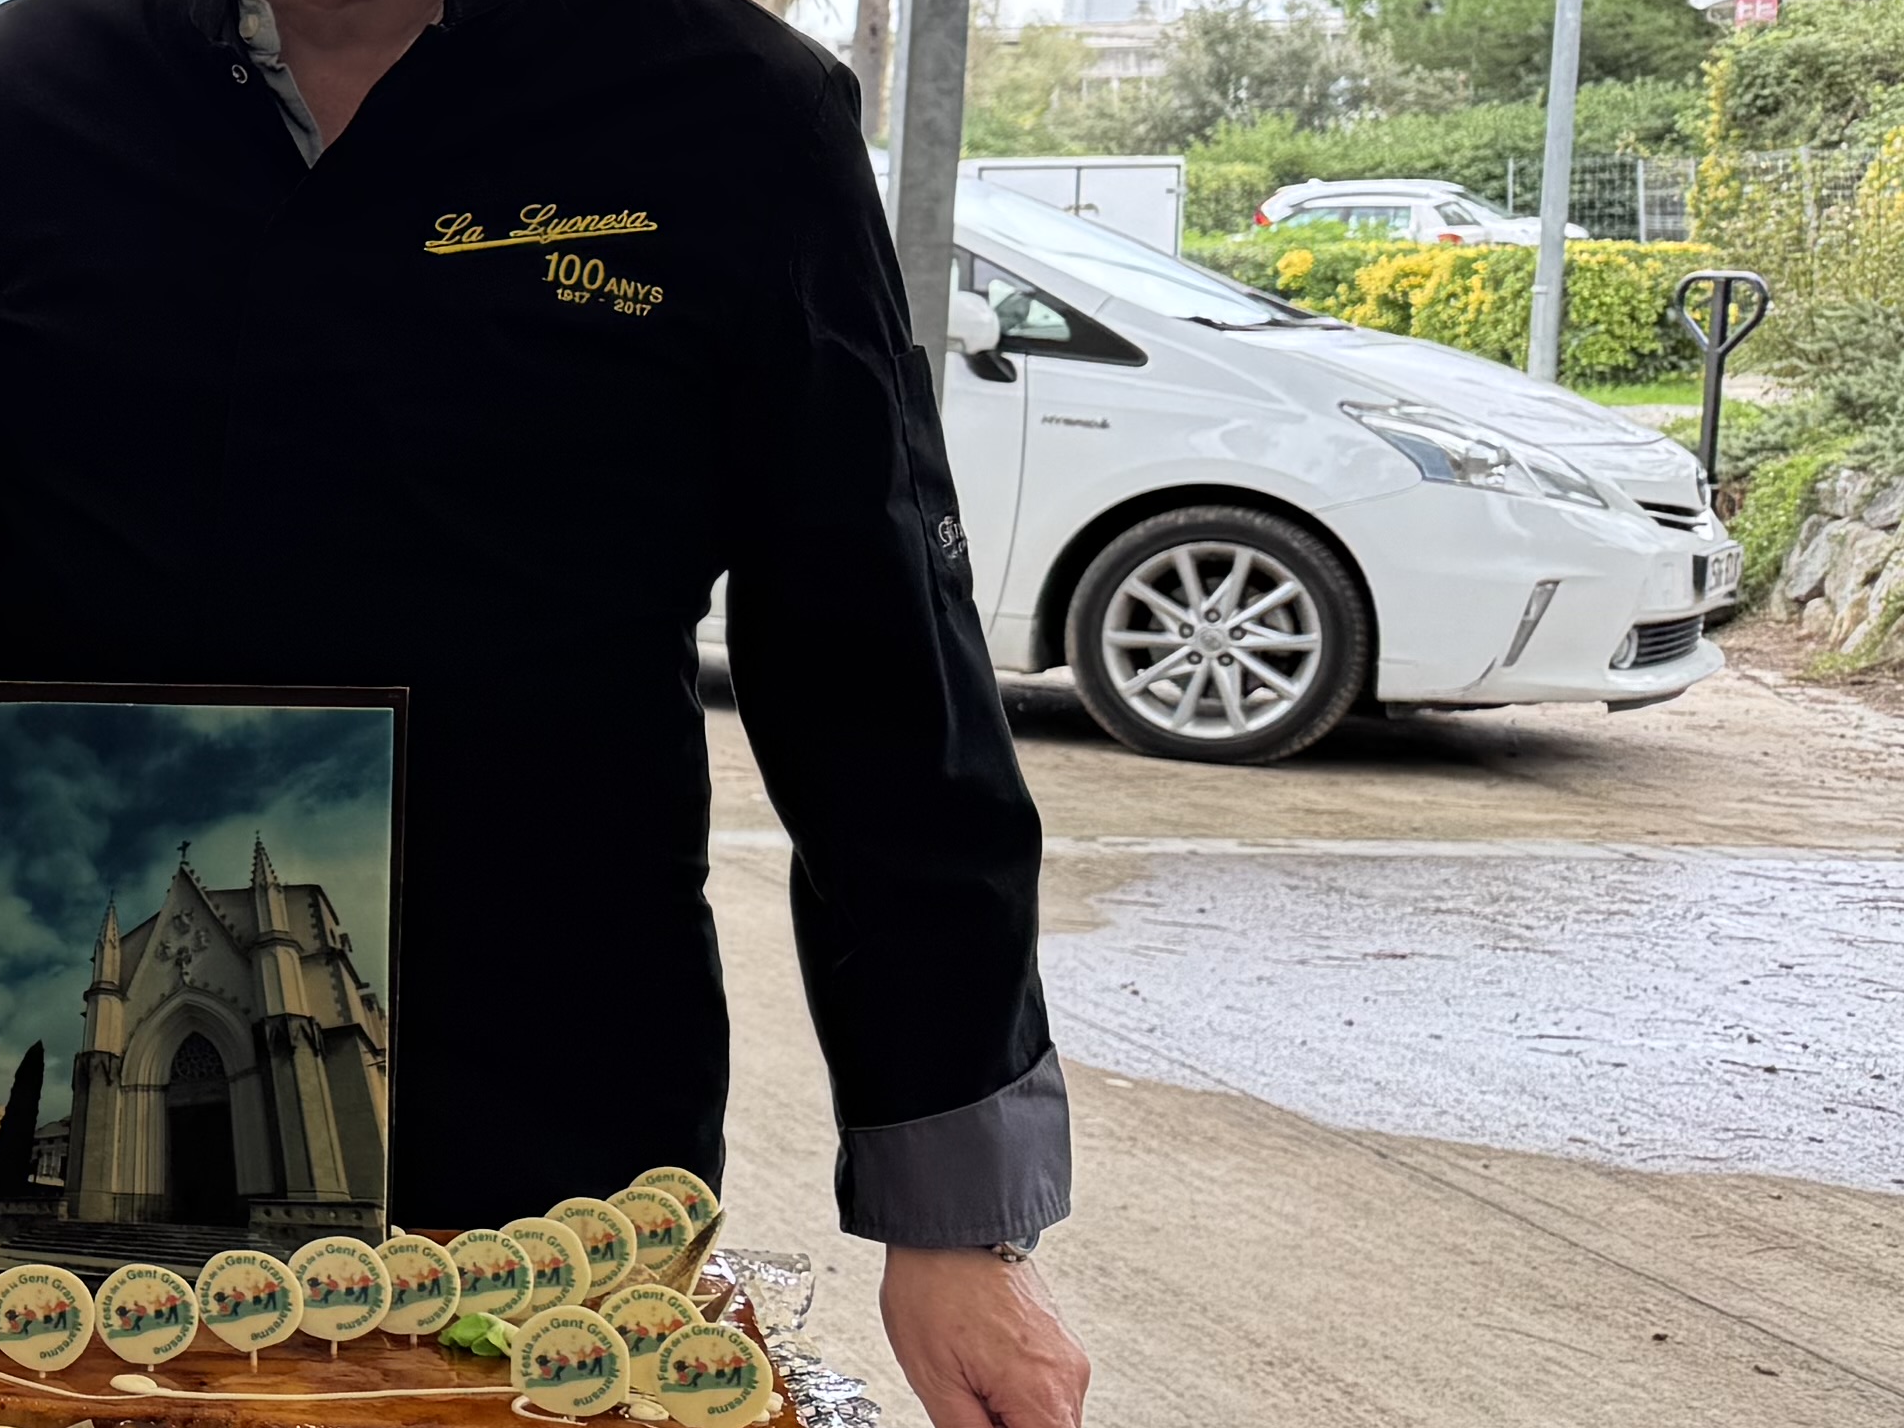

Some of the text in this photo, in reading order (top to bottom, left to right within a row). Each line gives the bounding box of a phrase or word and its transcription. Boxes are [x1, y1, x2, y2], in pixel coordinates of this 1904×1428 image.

[425, 204, 658, 247] La Lyonesa
[556, 288, 591, 304] 1917
[613, 300, 651, 316] 2017
[18, 1274, 49, 1285] Gent
[52, 1279, 75, 1304] Gran
[550, 1318, 584, 1329] Gent
[587, 1323, 612, 1349] Gran
[691, 1325, 726, 1338] Gent
[729, 1333, 753, 1360] Gran
